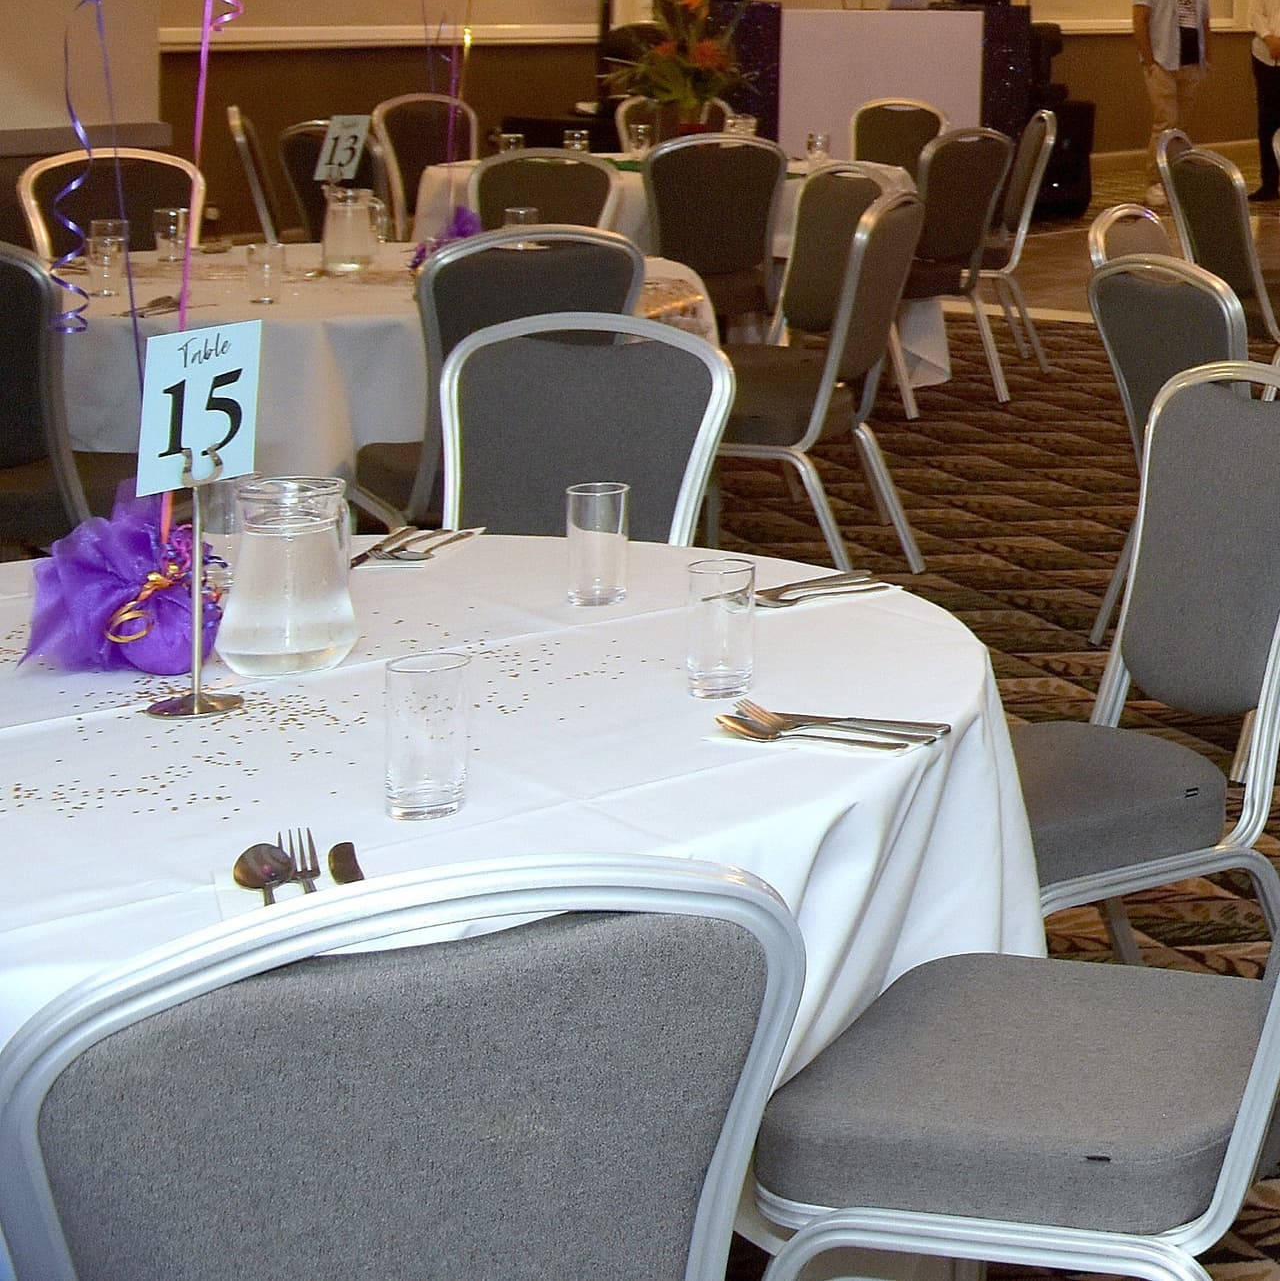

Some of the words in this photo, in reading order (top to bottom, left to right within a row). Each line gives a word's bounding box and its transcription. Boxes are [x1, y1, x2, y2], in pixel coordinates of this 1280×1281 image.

[324, 134, 359, 168] 13
[177, 332, 232, 368] Table
[158, 368, 243, 458] 15
